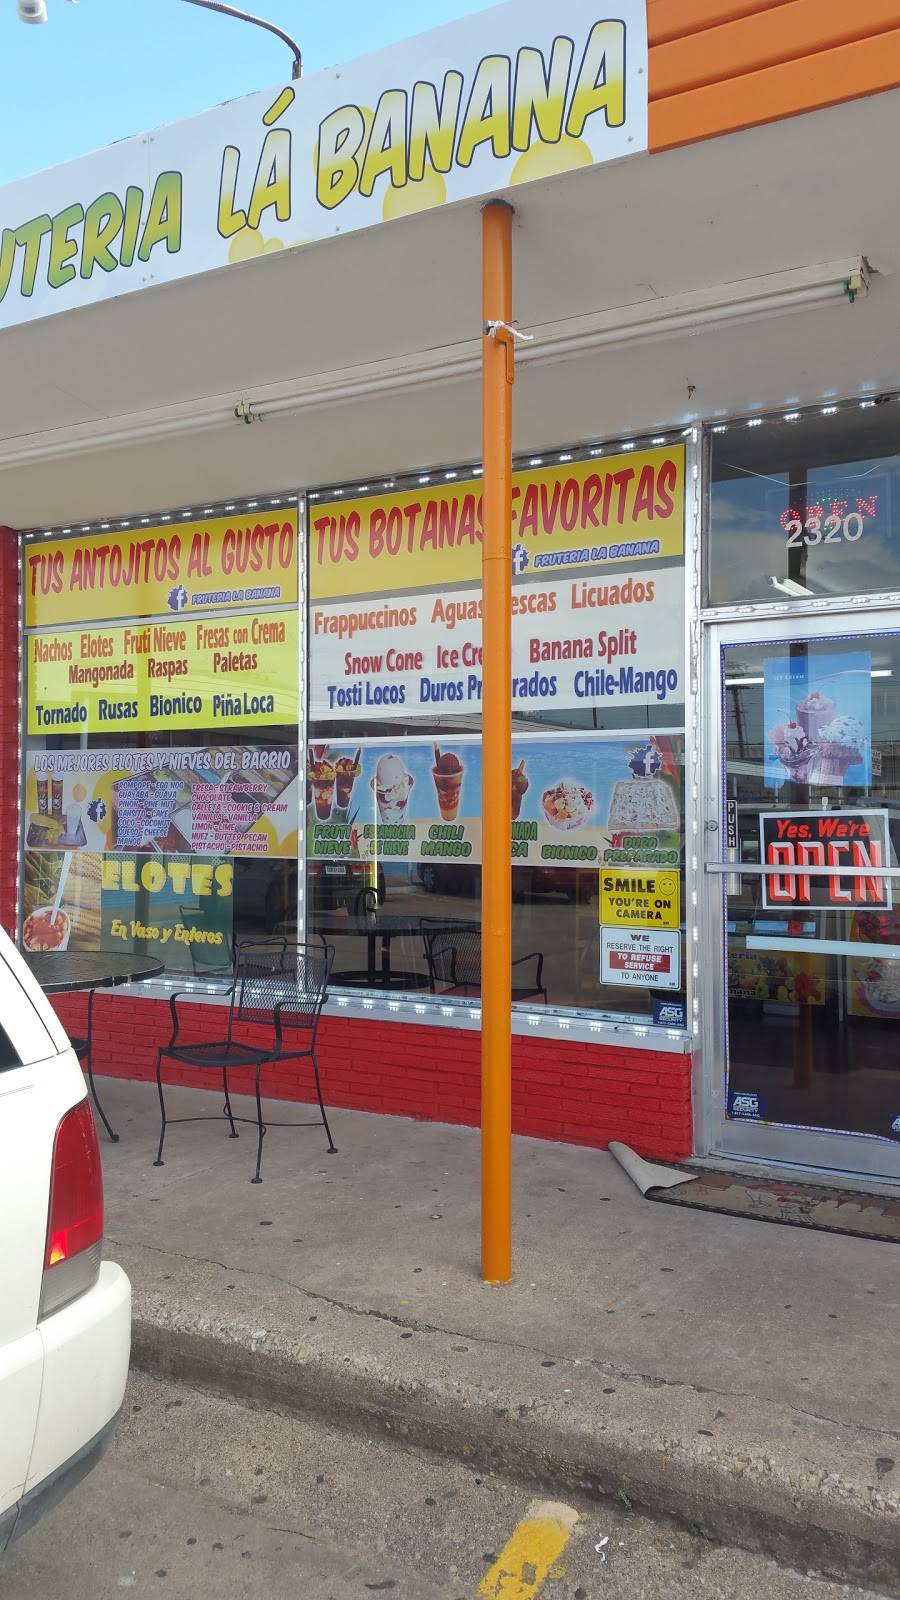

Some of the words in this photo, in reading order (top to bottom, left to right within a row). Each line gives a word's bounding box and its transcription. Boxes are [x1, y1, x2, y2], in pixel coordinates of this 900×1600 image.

[217, 86, 296, 239] LÁ
[315, 19, 627, 210] BANANA
[314, 511, 361, 565] TUS
[368, 494, 483, 559] BOTANA
[785, 512, 864, 548] 2320
[28, 550, 65, 596] TUS
[69, 534, 182, 592] ANTOJITOS
[187, 532, 213, 578] AL
[220, 522, 294, 575] GUSTO
[534, 550, 589, 568] FRUTERIA
[591, 548, 606, 561] LA
[609, 540, 660, 558] BANANA
[191, 592, 231, 605] FRUTERIA
[232, 590, 244, 601] LA
[245, 586, 280, 600] BANANA
[314, 605, 417, 639] Frappuccinos
[511, 592, 557, 616] escas
[571, 578, 655, 610] Licuados
[34, 638, 73, 663] Nachos
[80, 635, 114, 659] Elotes
[124, 628, 151, 655] Fruti
[153, 629, 187, 653] Nieve
[196, 624, 229, 650] Fresas
[233, 627, 249, 644] con
[251, 618, 285, 644] Crema
[344, 651, 382, 675] Snow
[386, 649, 423, 672] Cone
[436, 645, 459, 668] Ice
[529, 638, 593, 664] Banana
[597, 629, 637, 664] Split
[69, 660, 134, 688] Mangonada
[147, 658, 188, 682] Raspas
[213, 652, 258, 673] Paletas
[327, 682, 362, 709] Tosti
[366, 682, 406, 706] Locos
[420, 677, 464, 702] Duros
[574, 666, 678, 701] Chile-Mango
[35, 702, 87, 726] Tornado
[98, 699, 138, 721] Rusas
[150, 692, 202, 717] Bionico
[34, 754, 54, 771] LOS
[56, 754, 109, 771] MEJORES
[112, 753, 154, 771] ELOTES
[157, 752, 166, 770] Y
[169, 752, 211, 770] NIEVES
[214, 752, 237, 769] DEL
[241, 750, 291, 769] BARRIO
[118, 791, 149, 799] GUAYABA
[219, 783, 267, 792] STRAWBERRY
[192, 793, 231, 801] CHOCOLATE
[261, 804, 288, 812] CREAM
[219, 823, 235, 831] LIME
[314, 824, 351, 839] FRUTI
[727, 802, 735, 847] PUSH
[817, 818, 871, 838] We're
[243, 833, 267, 841] PECAN
[428, 825, 465, 840] CHILI
[231, 843, 268, 851] PISTACHIO
[314, 841, 351, 856] NIEVE
[384, 841, 410, 856] NIEVE
[421, 841, 473, 857] MANGO
[623, 837, 658, 850] DURO
[541, 844, 598, 861] BIONICO
[603, 849, 679, 864] PREPARADO
[101, 860, 233, 896] ELOTES
[768, 840, 884, 903] OPEN
[603, 877, 656, 893] SMILE
[609, 897, 649, 908] YOU'RE
[654, 899, 671, 909] ON
[616, 909, 662, 920] CAMERA
[110, 919, 128, 941] En
[130, 920, 160, 939] Vaso
[160, 928, 172, 944] y
[174, 923, 224, 945] Enteros
[630, 934, 650, 942] WE
[606, 942, 636, 951] RESERVE
[639, 944, 651, 952] THE
[653, 945, 674, 954] RIGHT
[617, 952, 628, 961] TO
[630, 953, 662, 963] REFUSE
[624, 961, 655, 971] SERVICE
[621, 972, 629, 980] TO
[632, 973, 659, 982] ANYONE
[659, 1006, 684, 1018] ASG
[733, 1096, 759, 1107] ASG
